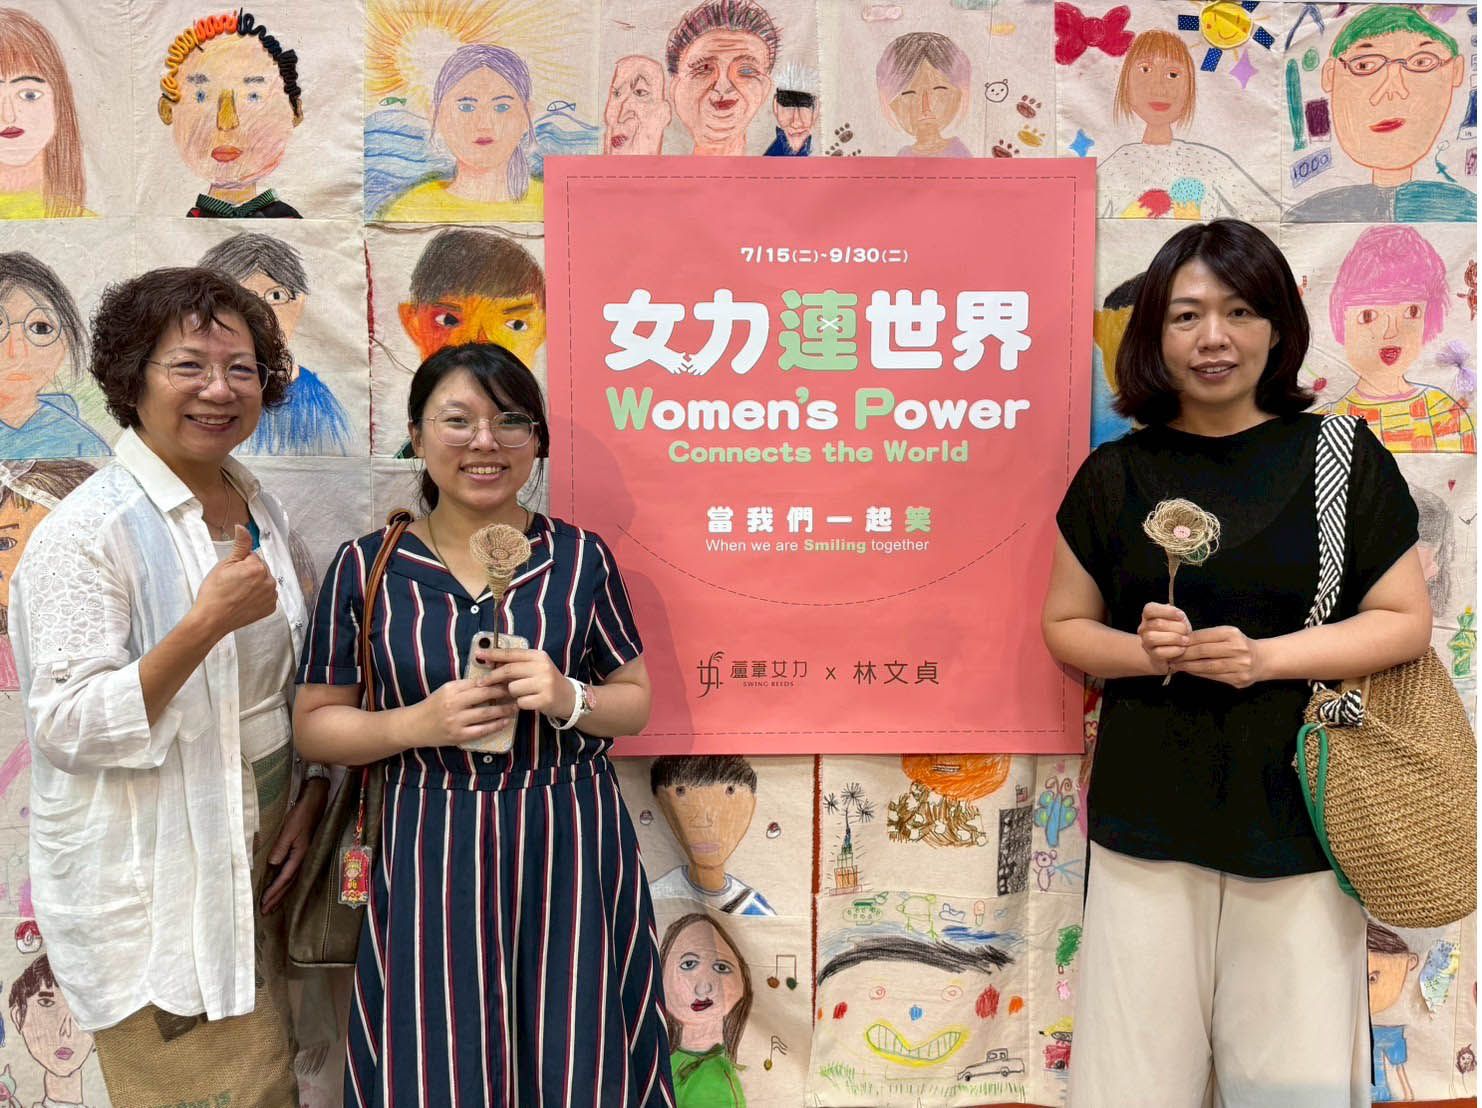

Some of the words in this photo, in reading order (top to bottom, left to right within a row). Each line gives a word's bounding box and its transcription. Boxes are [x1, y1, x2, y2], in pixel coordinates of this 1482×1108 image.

[602, 289, 1033, 376] 女力連世界
[606, 386, 840, 431] Women's
[854, 387, 1031, 431] Power
[668, 441, 812, 464] Connects
[821, 441, 874, 464] the
[884, 440, 969, 464] World
[706, 506, 932, 533] 當我們一起笑
[705, 538, 746, 551] When
[751, 541, 771, 551] we
[776, 541, 798, 551] are
[804, 538, 866, 555] Smiling
[871, 538, 929, 554] together
[853, 660, 940, 685] 林文貞
